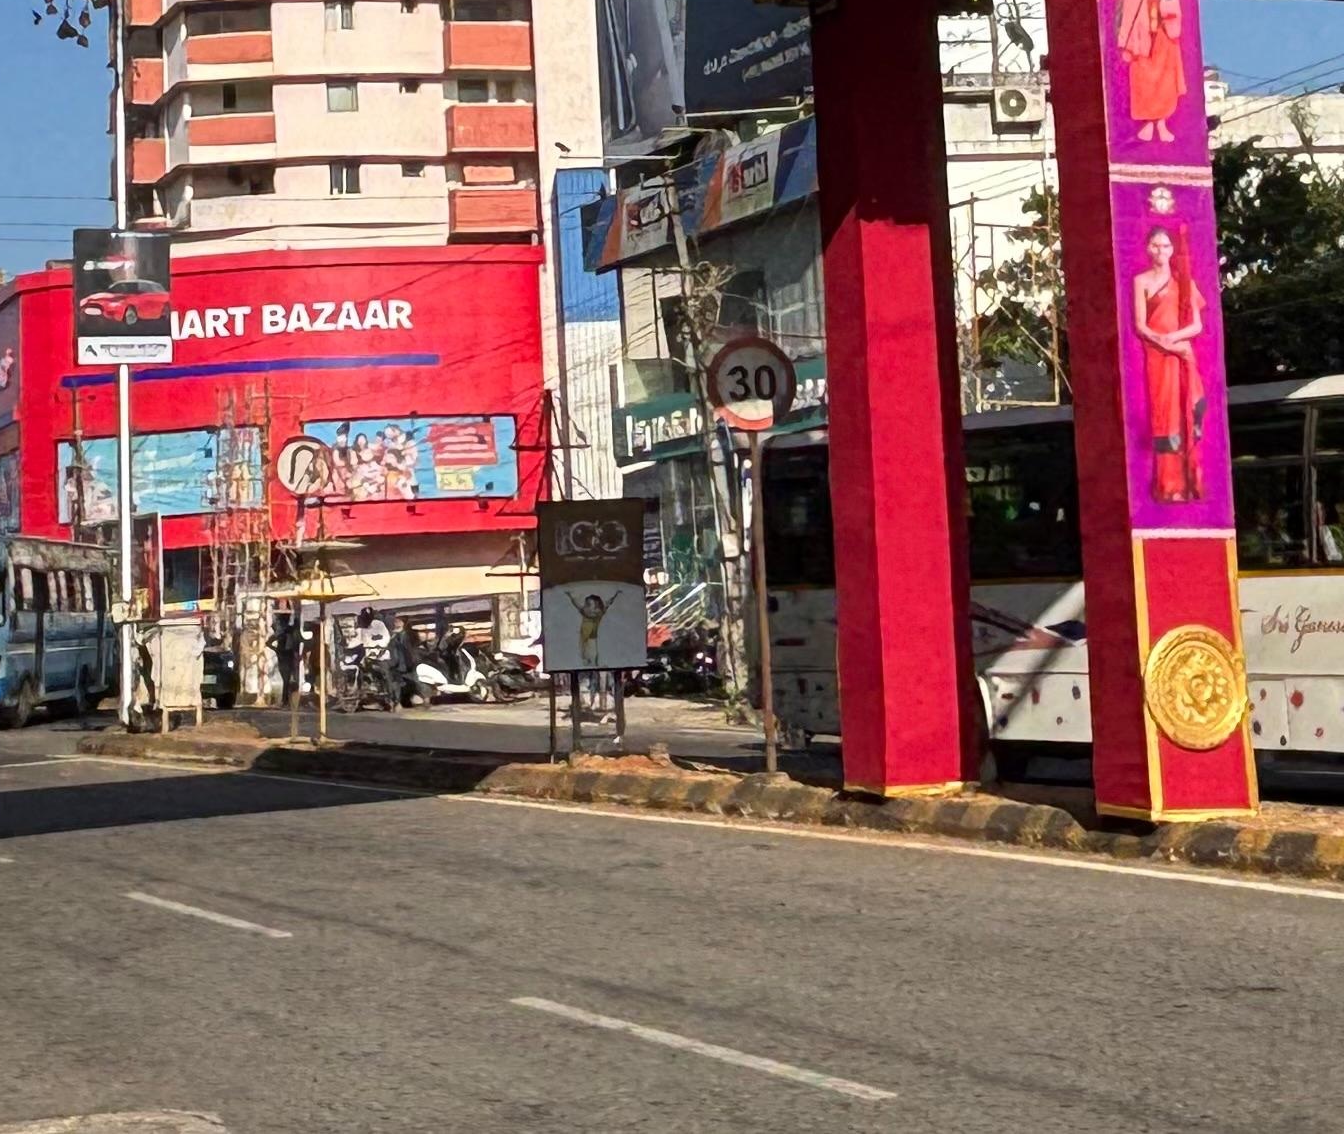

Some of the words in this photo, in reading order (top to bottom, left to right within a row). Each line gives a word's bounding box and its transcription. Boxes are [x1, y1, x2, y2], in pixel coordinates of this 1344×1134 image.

[171, 306, 251, 341] ART
[261, 299, 413, 336] BAZAAR
[726, 364, 777, 402] 30
